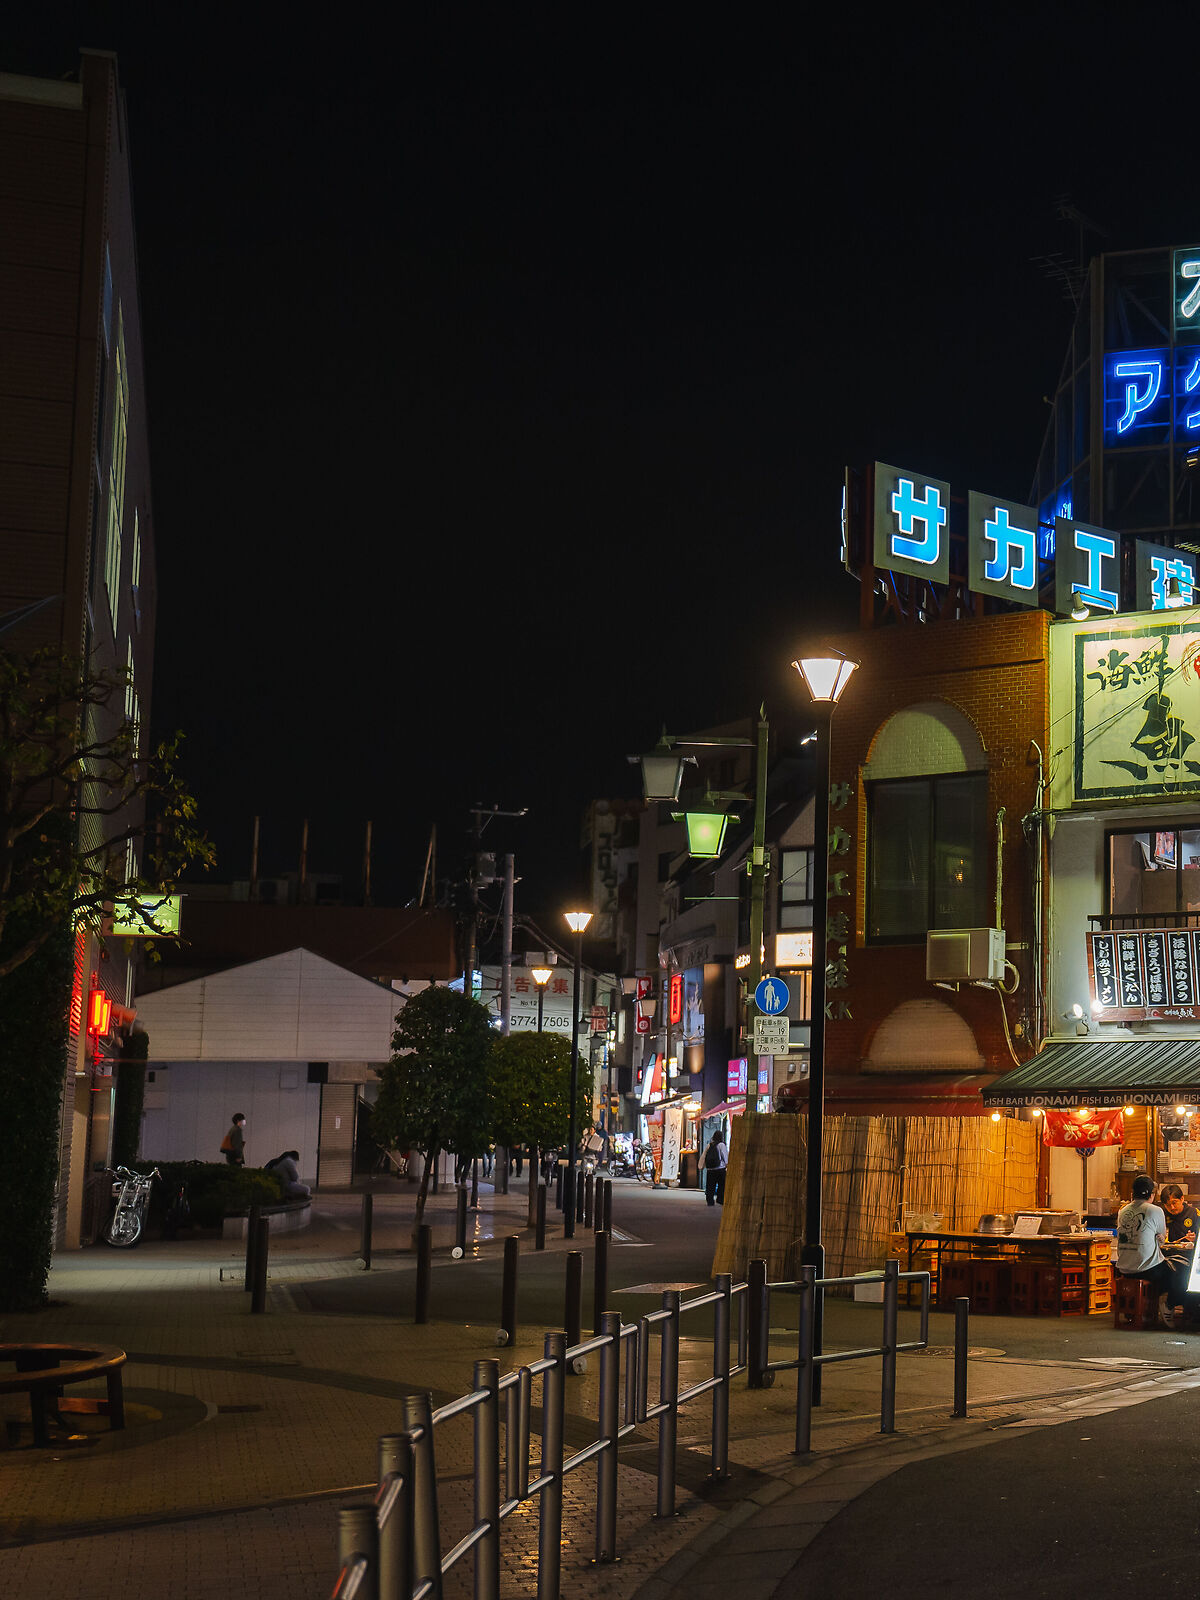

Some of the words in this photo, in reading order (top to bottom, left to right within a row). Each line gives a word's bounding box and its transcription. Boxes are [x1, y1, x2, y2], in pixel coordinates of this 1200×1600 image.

[1086, 633, 1174, 698] 海鮮
[1096, 940, 1114, 1004] しじみラーメン
[1005, 1097, 1024, 1105] BAR
[1025, 1095, 1078, 1106] UONAMI
[1081, 1096, 1102, 1105] FISH
[1103, 1095, 1122, 1104] BAR
[1123, 1093, 1180, 1105] UONAMI
[1062, 1120, 1121, 1142] おでん
